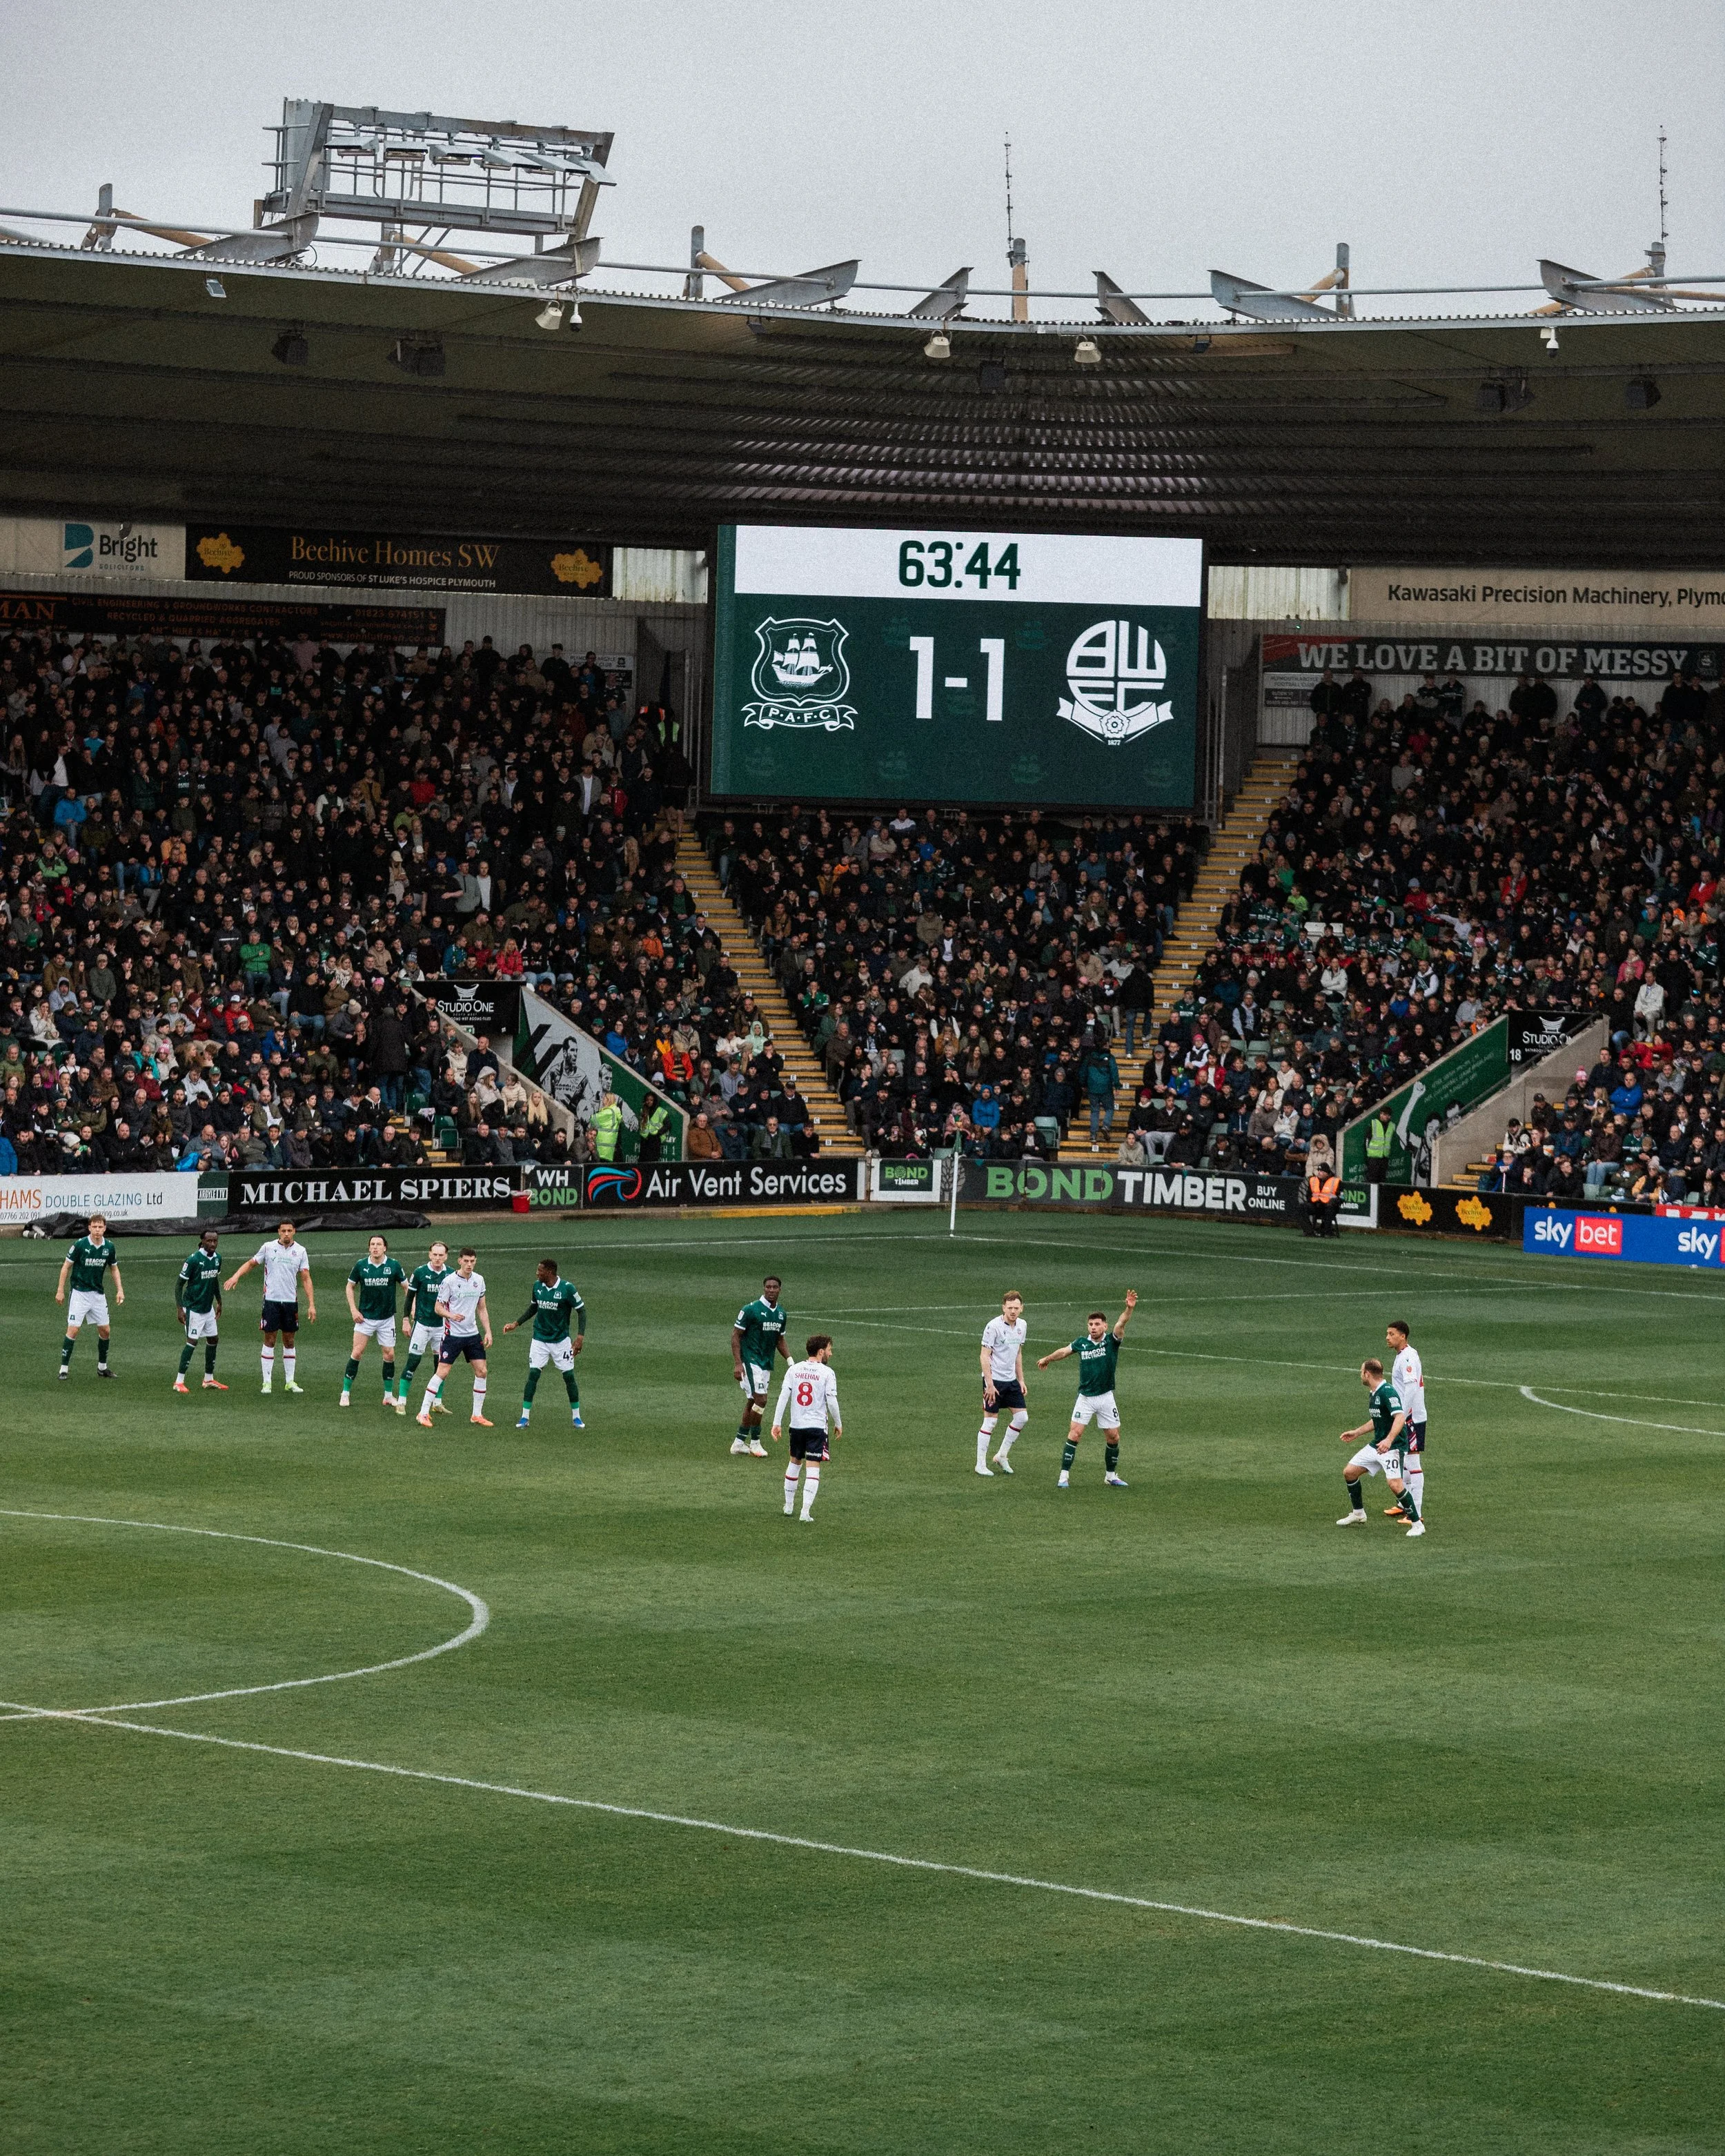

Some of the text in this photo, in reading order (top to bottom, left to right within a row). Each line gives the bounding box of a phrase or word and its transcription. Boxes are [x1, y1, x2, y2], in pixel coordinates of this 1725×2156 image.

[99, 534, 158, 562] Bright
[290, 537, 500, 568] Beehive Homes SW
[898, 540, 1021, 590] 63:44
[289, 571, 315, 582] PROUD
[317, 572, 356, 583] SPONSORS
[357, 573, 367, 582] OF
[368, 574, 378, 583] ST
[409, 575, 447, 586] HOSPICE
[448, 577, 496, 588] PLYMOUTH
[1388, 584, 1476, 602] Kawasaki
[1481, 585, 1568, 604] Precision
[1573, 586, 1673, 609] Machinery,
[72, 598, 94, 607] CIVIL
[97, 599, 160, 610] ENGINEERING
[172, 602, 245, 613] GROUNDWORKS
[249, 604, 319, 616] CONTRACTORS
[107, 611, 156, 622] RECYCLED
[168, 614, 215, 624] QUARRIED
[219, 615, 281, 626] AGGREGATES
[1297, 643, 1688, 677] WE LOVE A BIT OF MESSY
[1509, 1048, 1521, 1062] 18
[536, 1170, 569, 1187] WH
[885, 1165, 928, 1180] BOND
[894, 1176, 919, 1185] TIMBER
[646, 1165, 846, 1198] Air Vent Services
[985, 1167, 1246, 1211] BOND TIMBER
[46, 1194, 90, 1208] DOUBLE
[94, 1192, 142, 1207] GLAZING
[146, 1191, 163, 1205] Ltd
[240, 1177, 511, 1205] MICHAEL SPIERS
[530, 1188, 578, 1206] BOND
[1256, 1185, 1277, 1197] BUY
[1248, 1197, 1285, 1211] ONLINE
[19, 1211, 29, 1220] 202
[1534, 1215, 1573, 1248] sky
[1579, 1218, 1617, 1247] bet
[1677, 1226, 1718, 1260] sky
[1081, 1347, 1106, 1356] BEACON
[795, 1372, 820, 1381] SHEEHAN
[797, 1382, 813, 1407] 8
[1112, 1407, 1118, 1418] 8
[1386, 1459, 1399, 1470] 20
